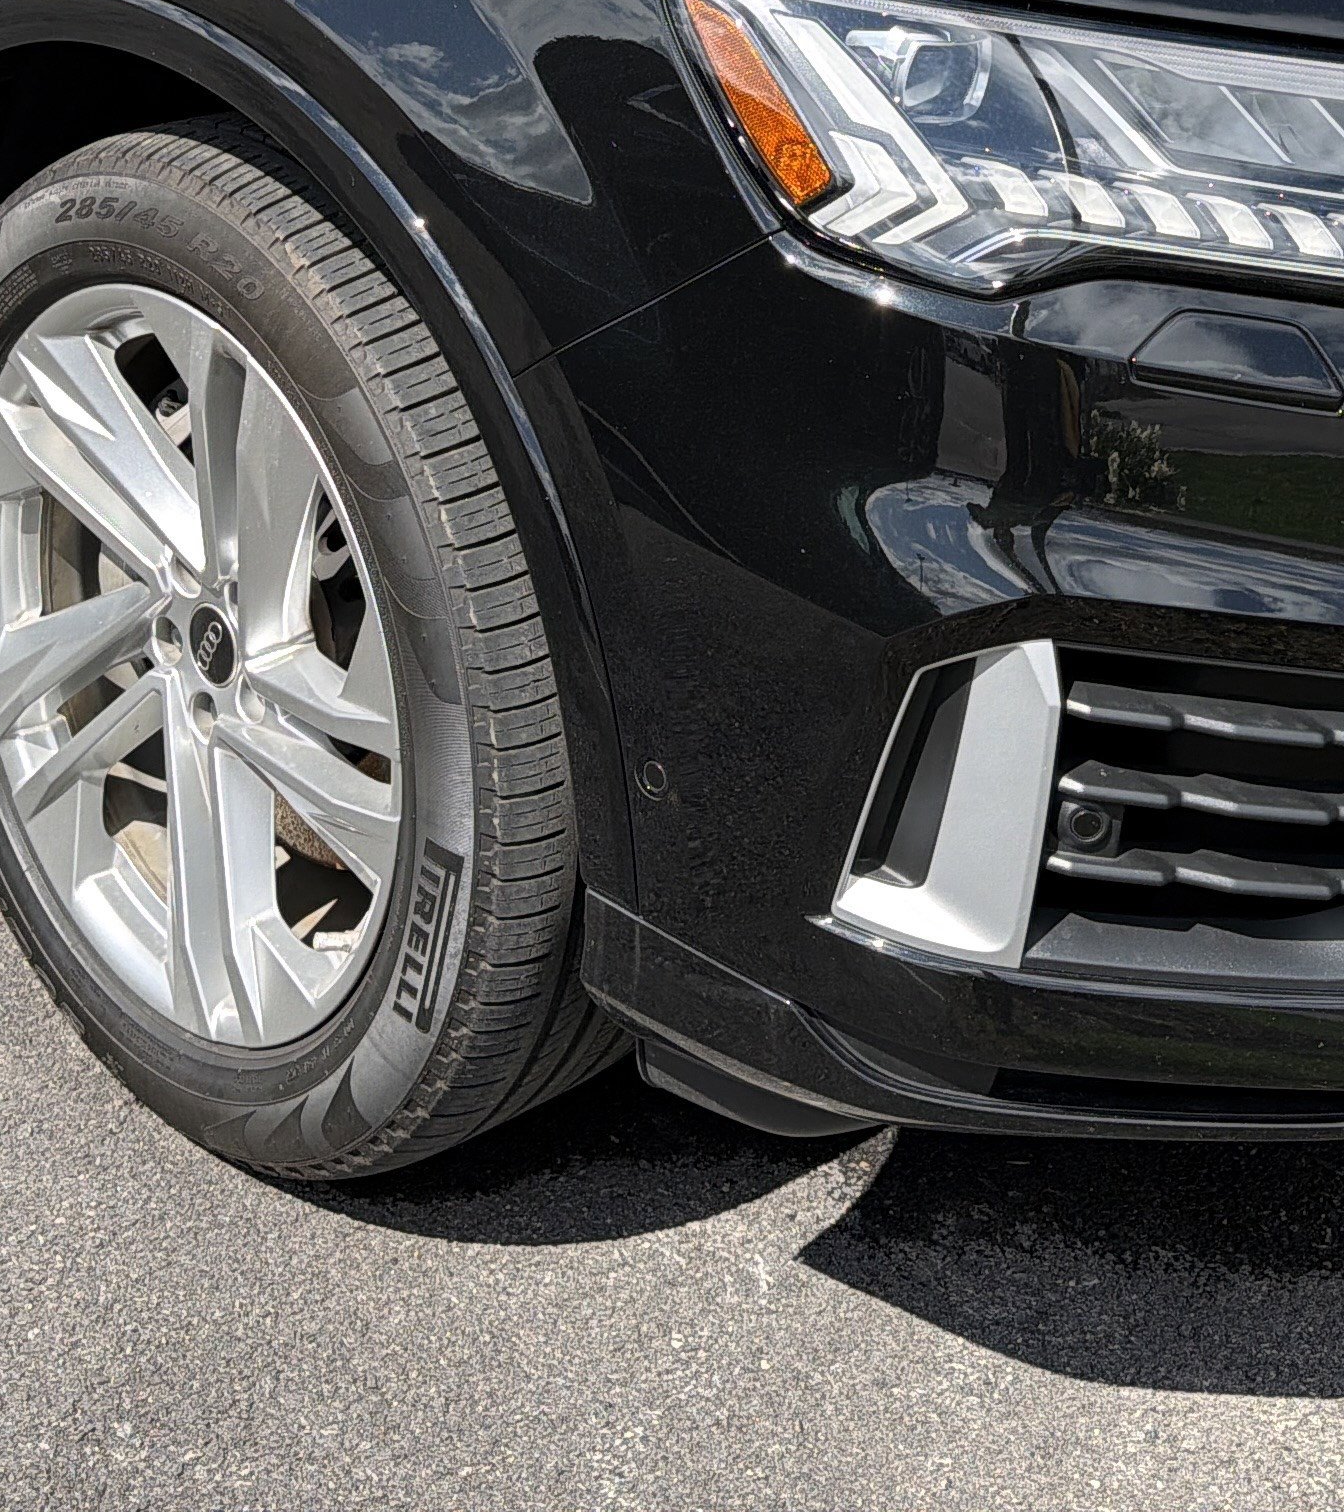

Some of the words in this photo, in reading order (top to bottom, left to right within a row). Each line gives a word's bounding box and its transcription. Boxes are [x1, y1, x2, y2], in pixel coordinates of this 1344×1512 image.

[55, 196, 185, 238] 285/45
[186, 231, 266, 301] R20
[392, 837, 465, 1034] PIRELLI
